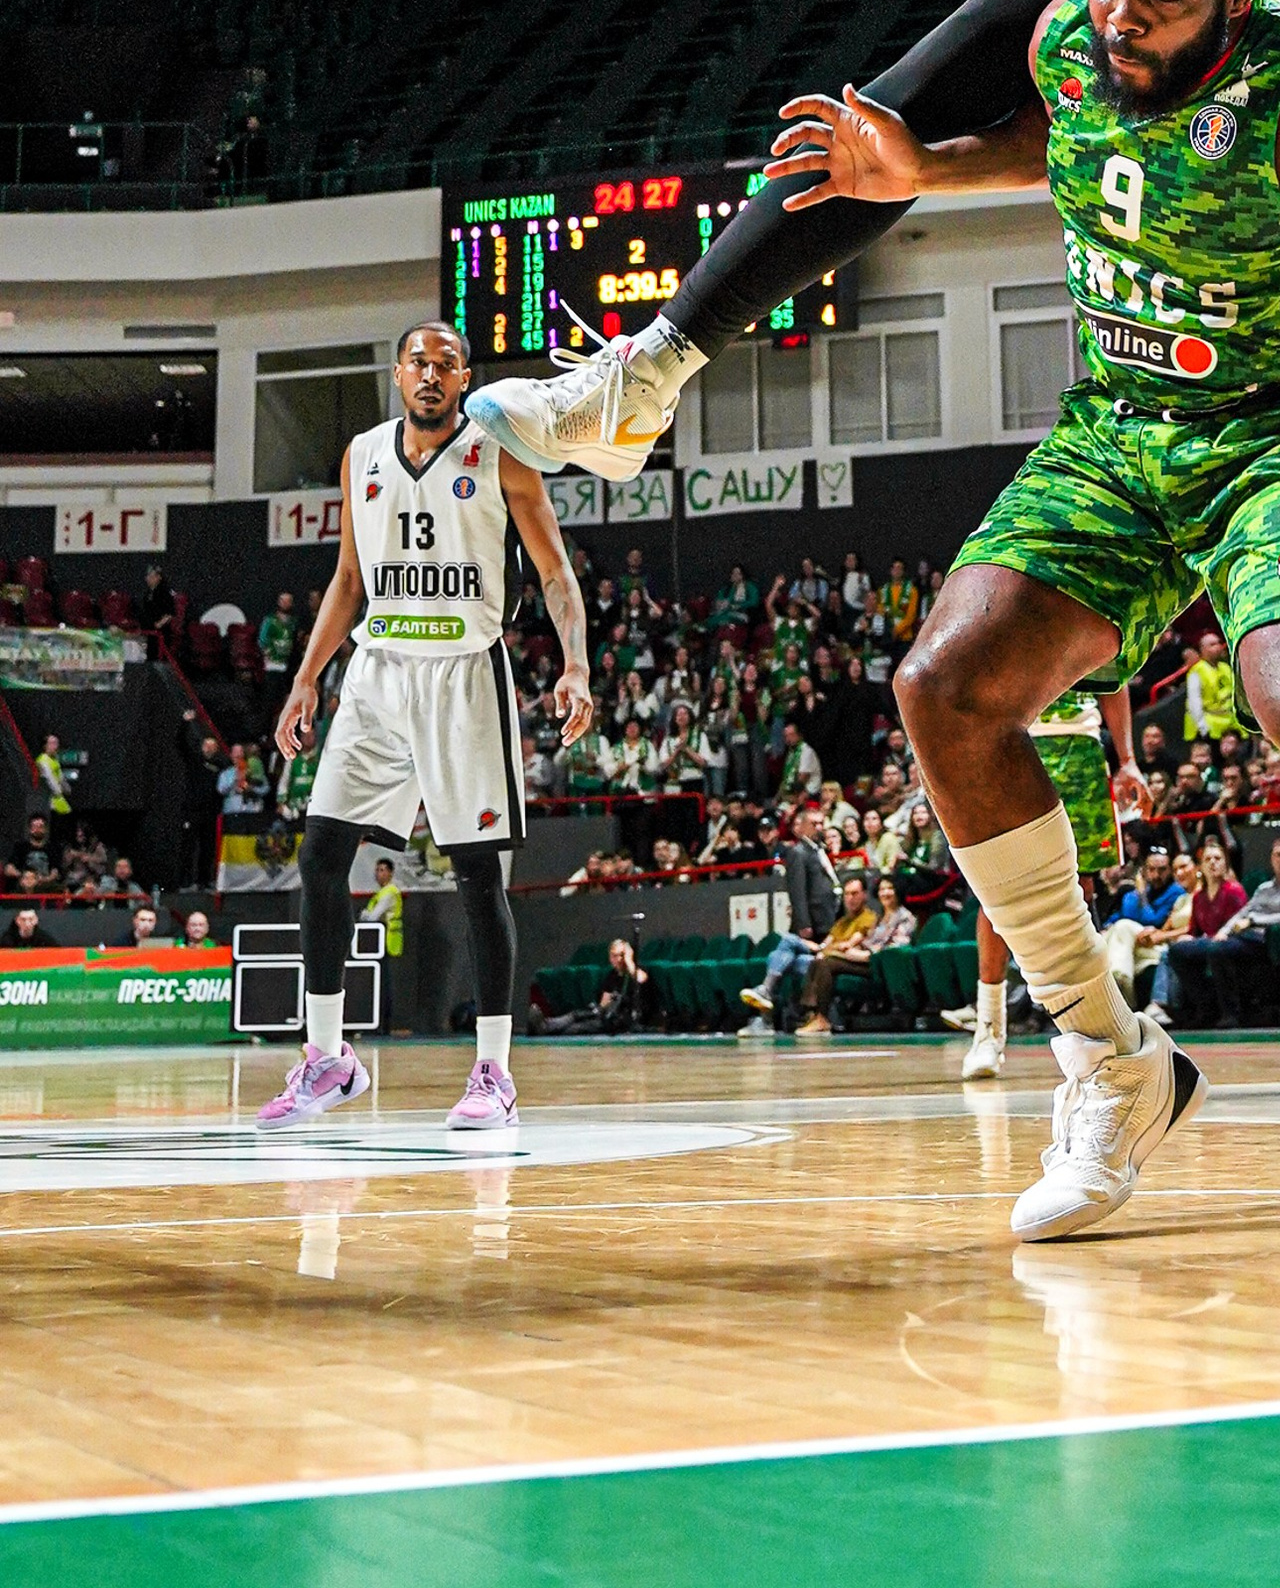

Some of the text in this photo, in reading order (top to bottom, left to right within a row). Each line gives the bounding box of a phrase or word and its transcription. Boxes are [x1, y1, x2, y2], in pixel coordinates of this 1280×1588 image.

[464, 193, 556, 224] UNICS KAZAN
[594, 175, 683, 214] 24 27
[1099, 153, 1145, 243] 9
[494, 236, 507, 256] 5
[522, 233, 542, 254] 11
[570, 229, 584, 250] 3
[629, 239, 647, 264] 2
[494, 256, 507, 276] 2
[522, 252, 545, 273] 15
[494, 275, 506, 296] 4
[522, 273, 545, 292] 19
[599, 268, 681, 304] 8:39.5
[521, 291, 543, 312] 21
[494, 313, 507, 333] 2
[521, 310, 544, 331] 27
[493, 333, 507, 354] 6
[520, 329, 544, 351] 45
[570, 326, 583, 347] 2
[1086, 317, 1164, 361] inline
[687, 465, 798, 512] САШУ
[77, 510, 145, 547] 1-Г
[397, 511, 435, 551] 13
[389, 619, 461, 636] БАЛТБЕТ
[118, 977, 232, 1004] ПРЕСС-ЗОНА
